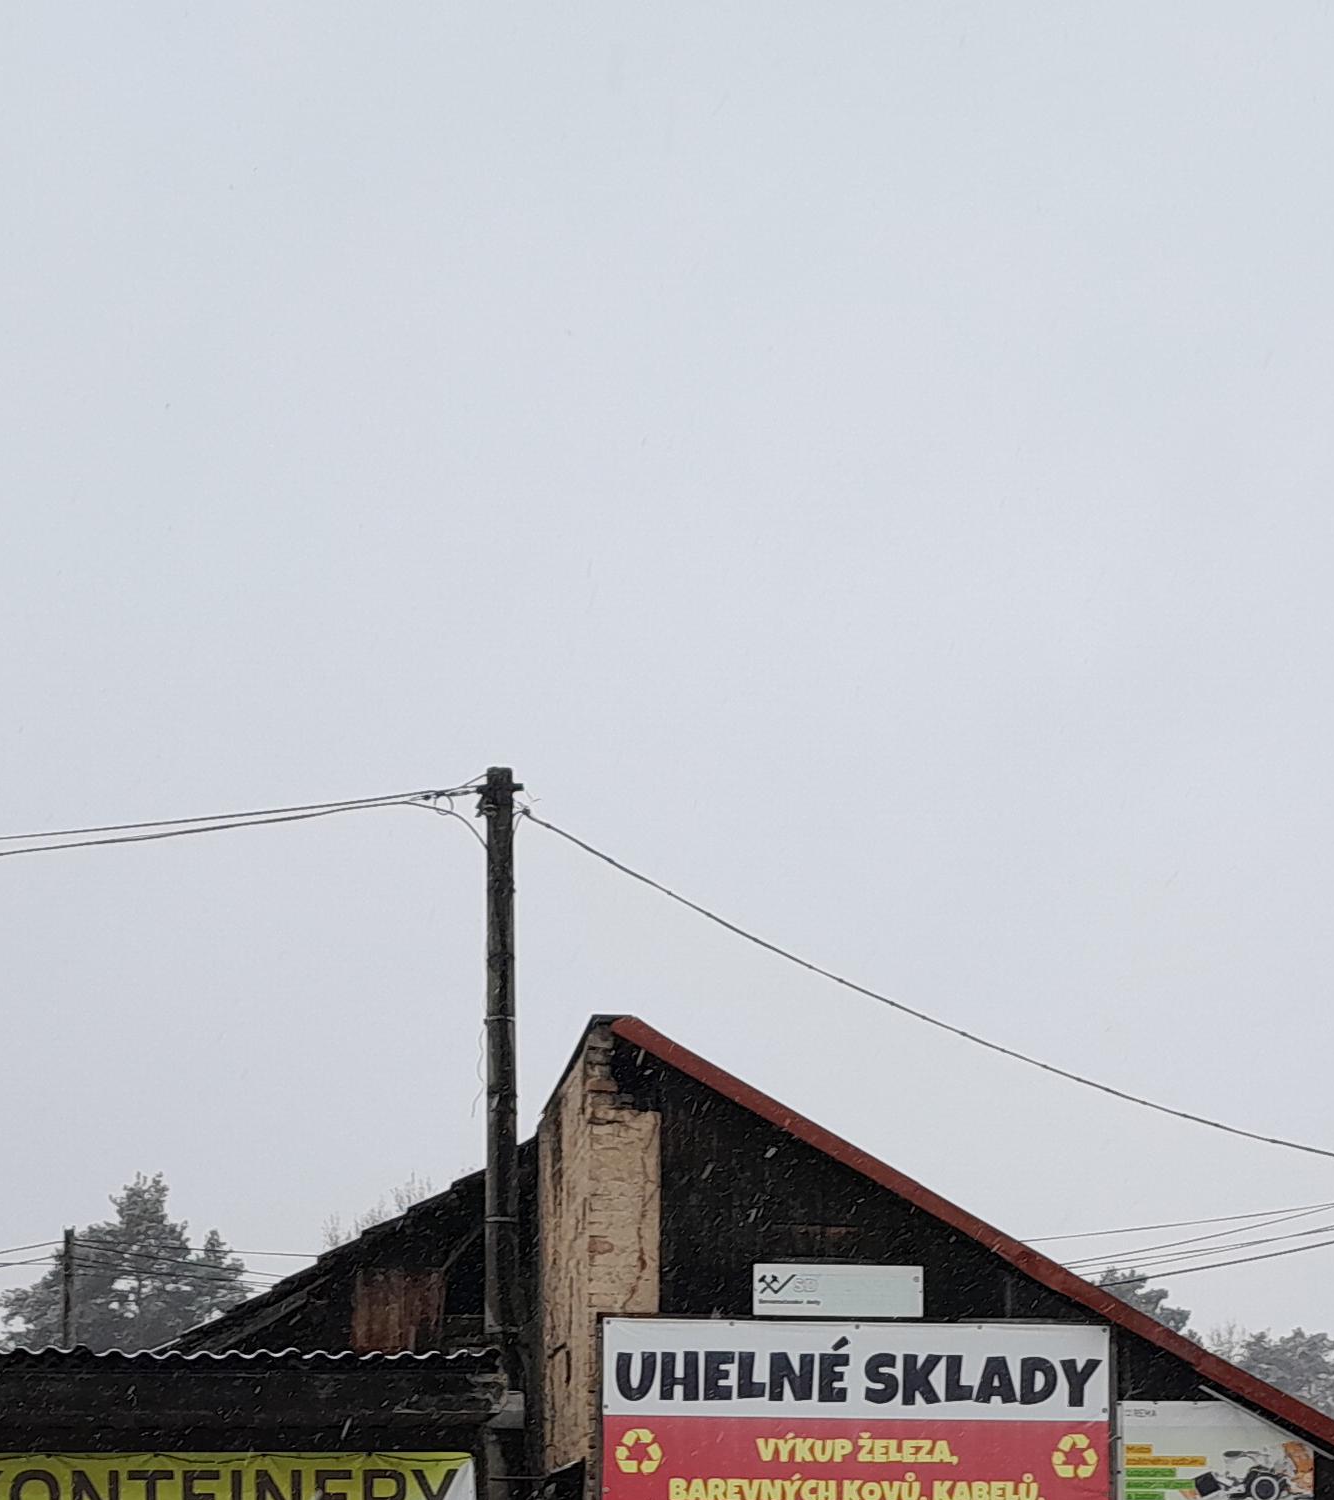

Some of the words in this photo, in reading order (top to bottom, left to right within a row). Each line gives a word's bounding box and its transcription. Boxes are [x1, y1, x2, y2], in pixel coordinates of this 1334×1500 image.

[615, 1336, 851, 1402] UHELNÉ
[864, 1353, 1102, 1407] SKLADY
[755, 1433, 852, 1463] VÝKUP
[856, 1431, 959, 1466] ŽELEZA,
